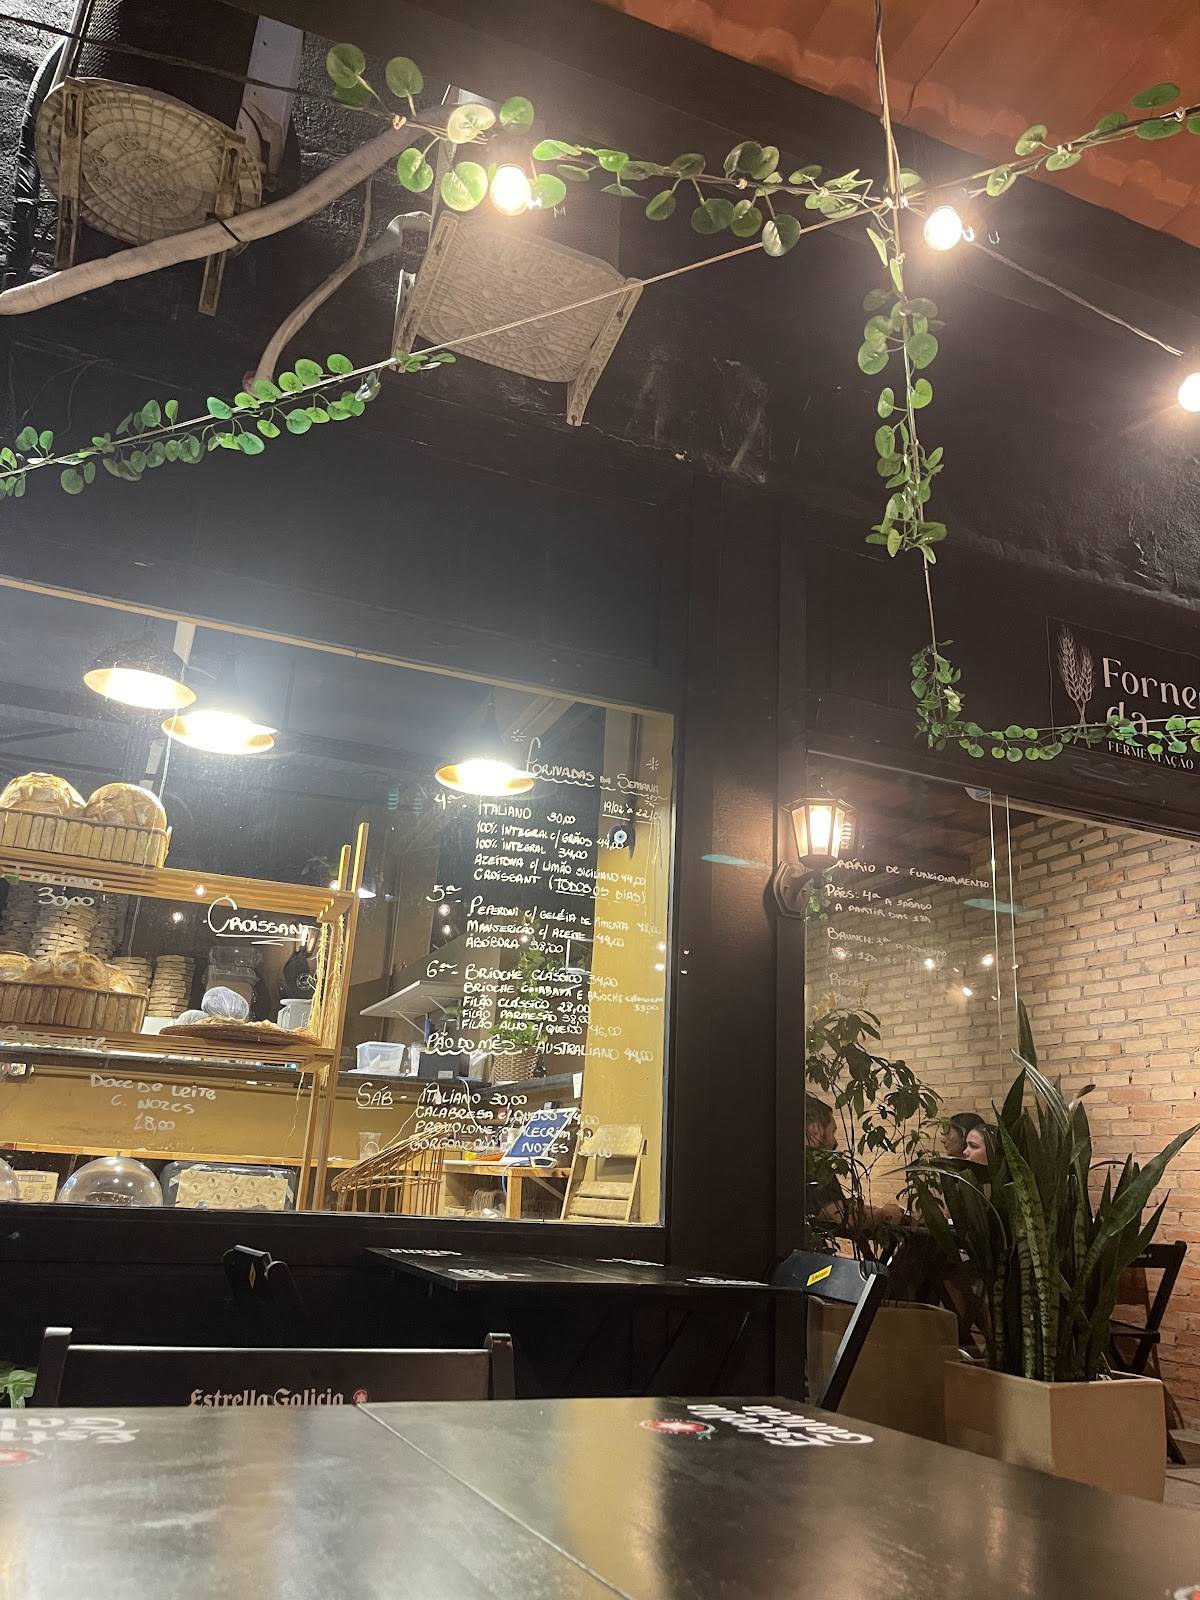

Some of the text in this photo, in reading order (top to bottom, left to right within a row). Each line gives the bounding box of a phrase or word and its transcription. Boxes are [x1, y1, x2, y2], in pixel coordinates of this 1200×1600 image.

[1102, 657, 1200, 710] Forne
[479, 800, 532, 819] ITALIANO
[476, 820, 498, 834] 100%
[502, 824, 549, 839] INTEGRAL
[475, 838, 498, 850] 100%
[502, 838, 547, 854] INTEGRAL
[473, 868, 542, 884] CROISSANT
[208, 896, 319, 938] CROISSANT
[465, 964, 523, 981] BRIOCHE
[463, 981, 515, 994] BRIOCHE
[356, 1082, 394, 1106] SÁB
[415, 1106, 494, 1120] CALABRESA
[188, 1388, 345, 1407] Estrella Galicia
